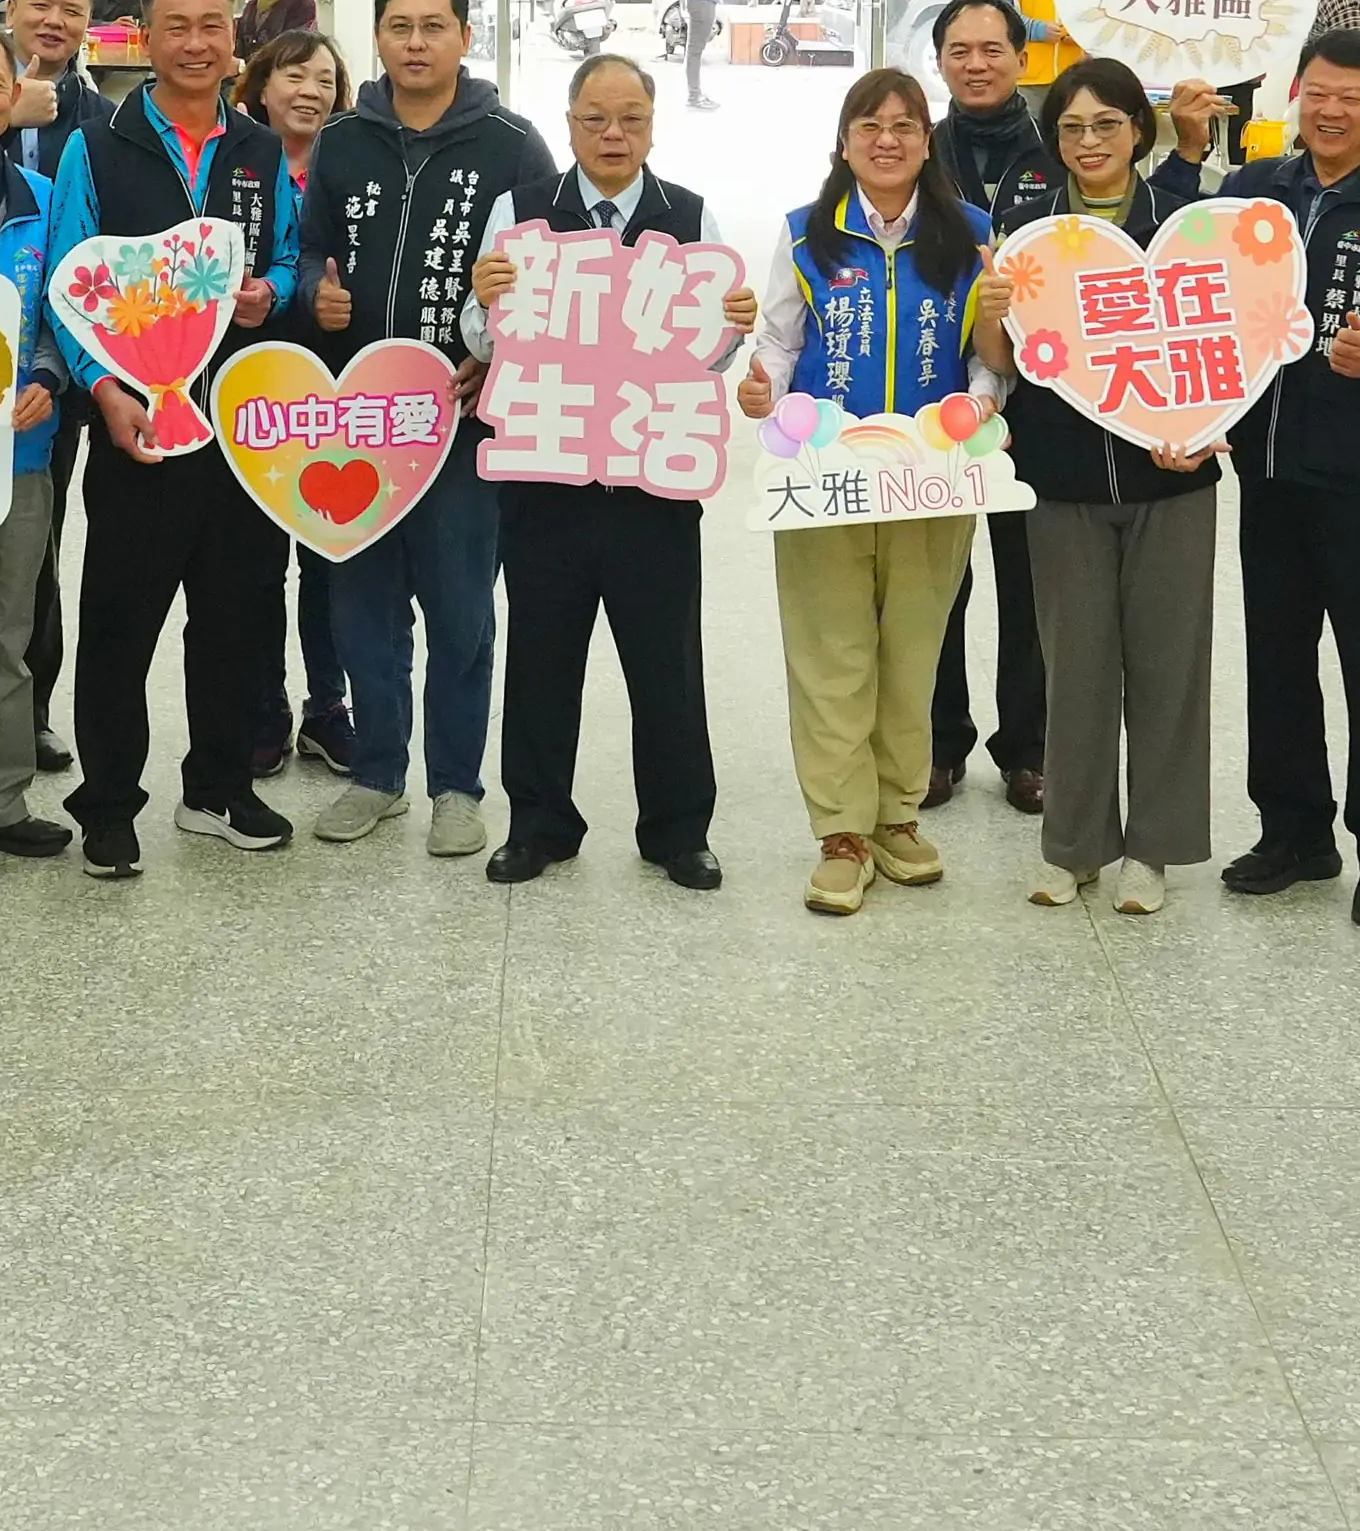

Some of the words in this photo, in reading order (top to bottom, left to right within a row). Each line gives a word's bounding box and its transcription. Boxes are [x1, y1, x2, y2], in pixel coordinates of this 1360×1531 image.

[418, 218, 450, 302] 吳建德
[495, 228, 738, 361] 新好
[1332, 254, 1348, 282] 里長
[856, 286, 875, 357] 立法委員
[1078, 262, 1233, 336] 愛在
[1090, 335, 1246, 414] 大雅
[235, 392, 441, 449] 心中有愛
[486, 360, 722, 490] 生活
[767, 469, 871, 521] 大雅
[878, 464, 986, 514] No.1
